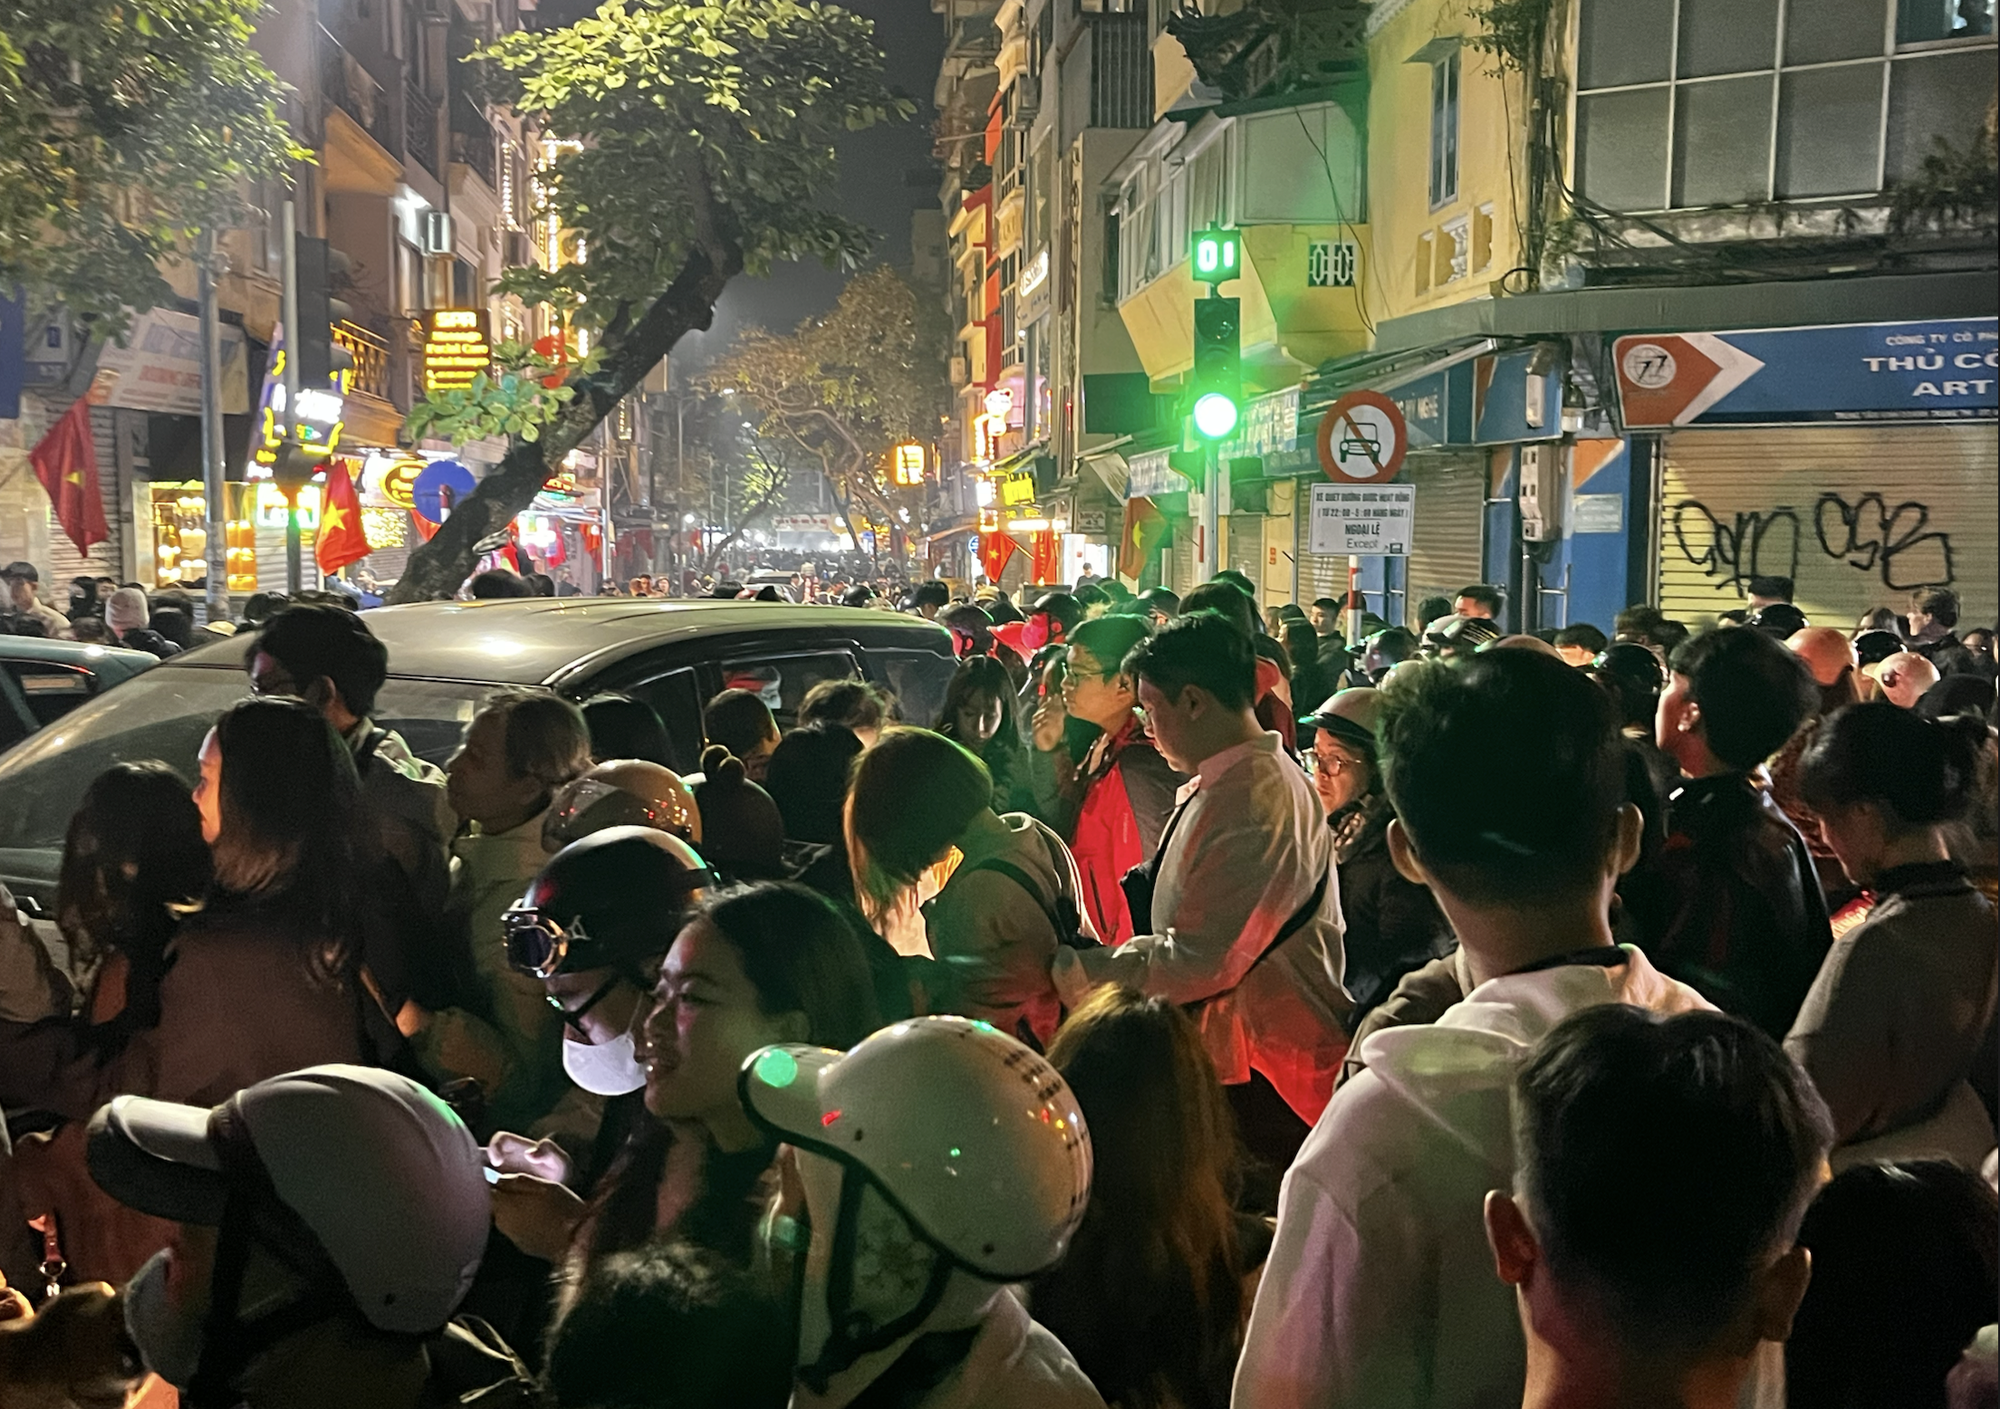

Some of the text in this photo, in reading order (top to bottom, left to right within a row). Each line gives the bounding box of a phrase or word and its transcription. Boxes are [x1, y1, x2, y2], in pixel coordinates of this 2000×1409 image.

[1197, 239, 1234, 272] 01
[1862, 347, 1945, 372] THỦ
[1912, 379, 1994, 396] ART
[1347, 538, 1378, 549] Except
